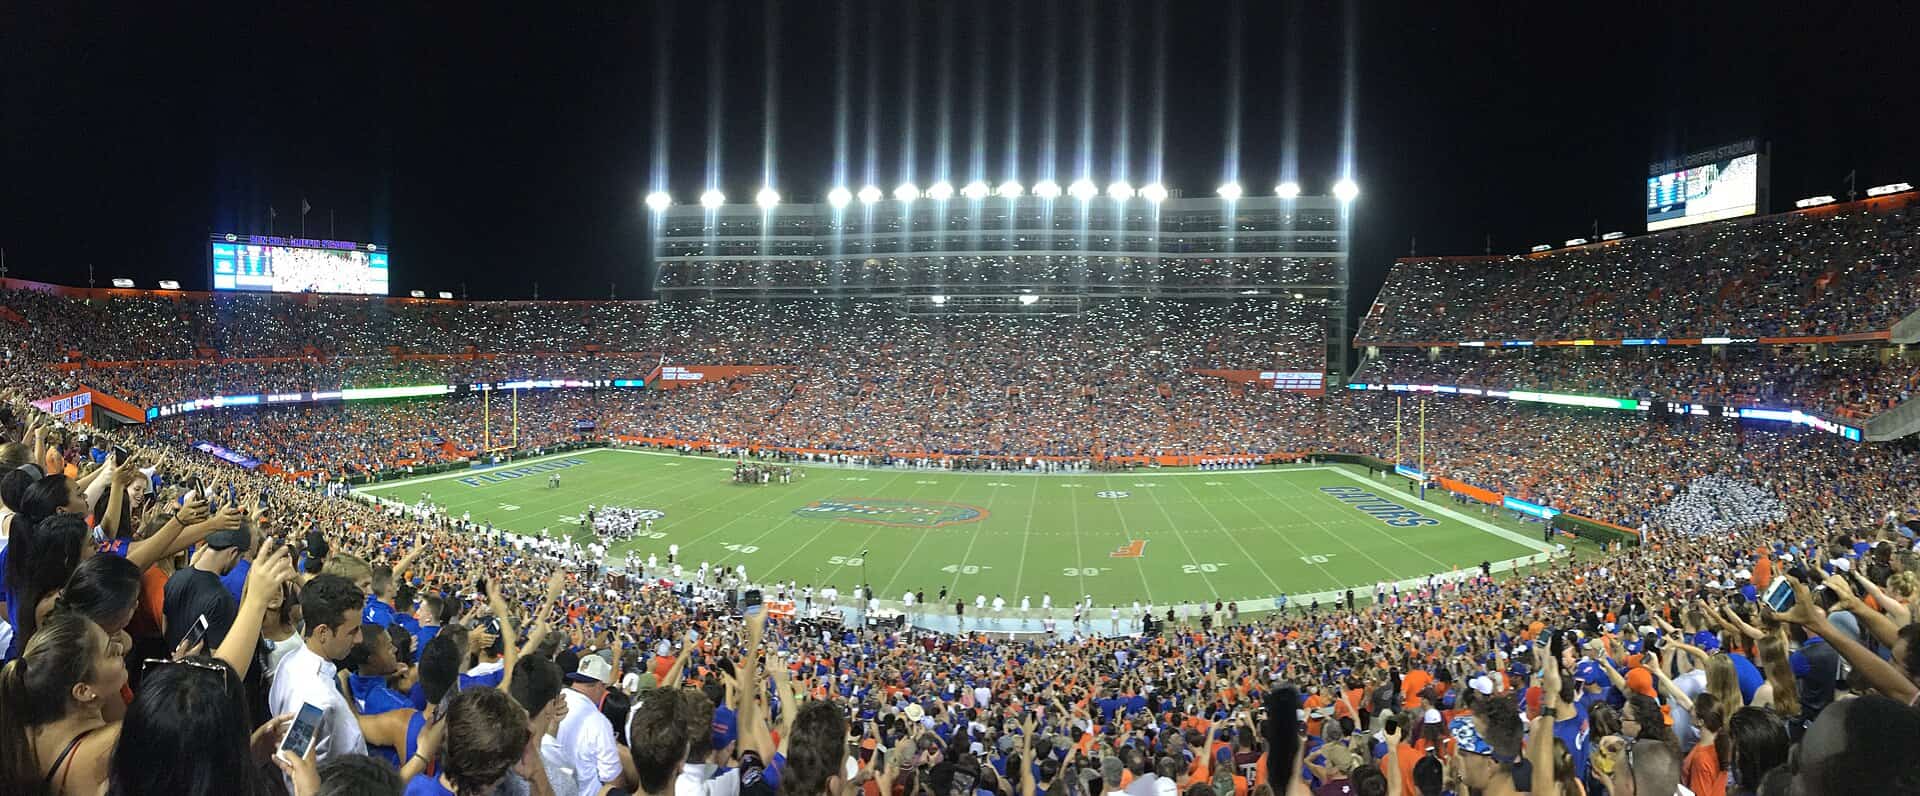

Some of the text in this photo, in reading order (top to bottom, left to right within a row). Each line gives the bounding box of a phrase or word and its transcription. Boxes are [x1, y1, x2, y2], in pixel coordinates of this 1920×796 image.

[458, 459, 588, 487] FLORIDA
[1319, 486, 1440, 527] GATORS
[724, 544, 760, 554] 40
[828, 555, 864, 566] 50
[1300, 554, 1329, 565] 10
[941, 564, 980, 575] 40
[1063, 567, 1100, 577] 30
[1181, 563, 1219, 574] 20
